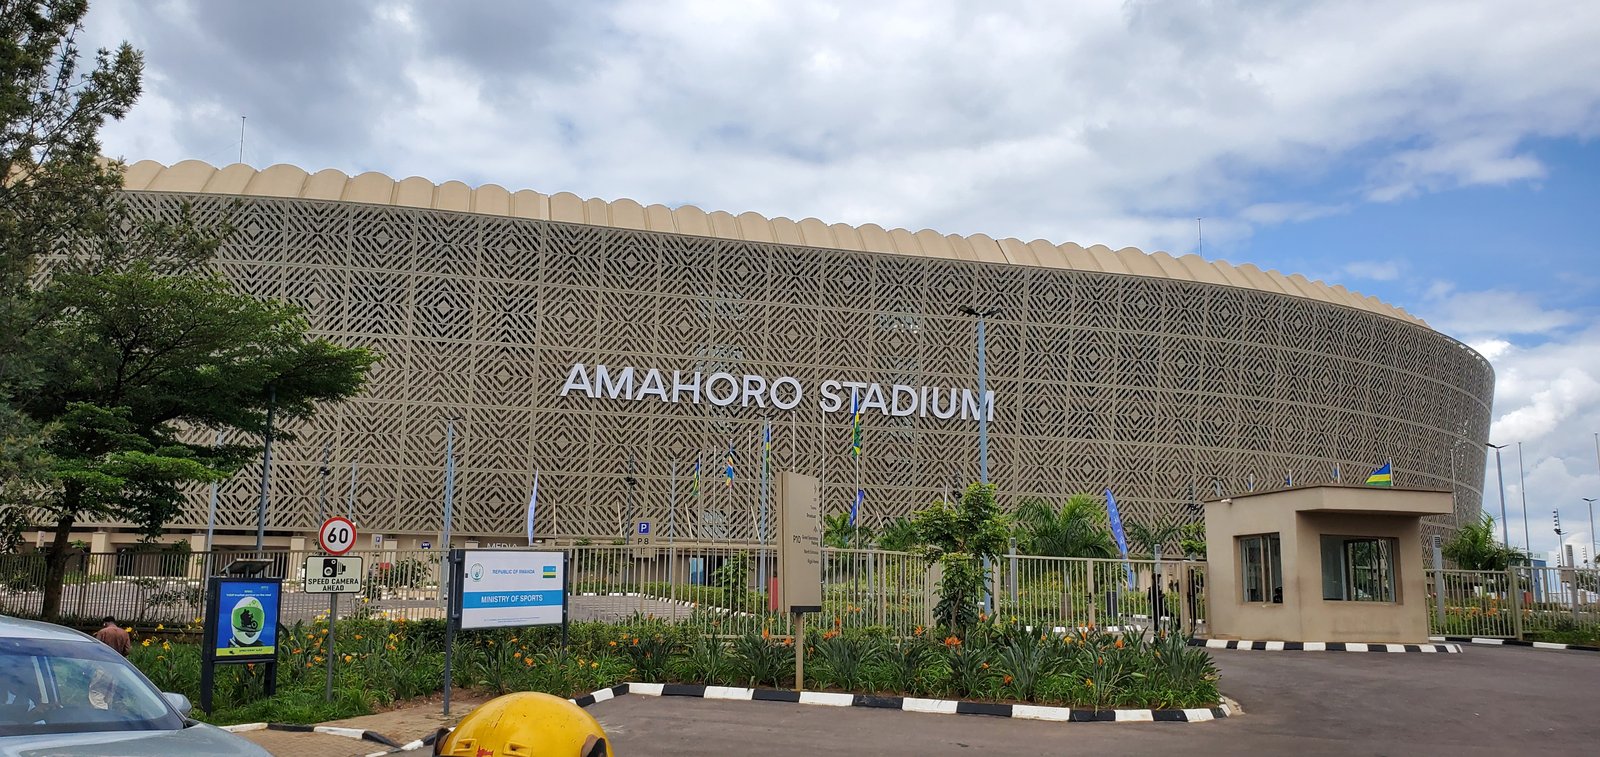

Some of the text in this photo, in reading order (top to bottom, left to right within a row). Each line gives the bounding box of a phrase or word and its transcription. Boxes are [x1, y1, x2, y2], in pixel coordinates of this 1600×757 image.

[561, 363, 996, 422] AMAHORO STADIUM
[328, 527, 348, 543] 60
[481, 595, 510, 603] MINISTRY
[520, 594, 543, 602] SPORTS
